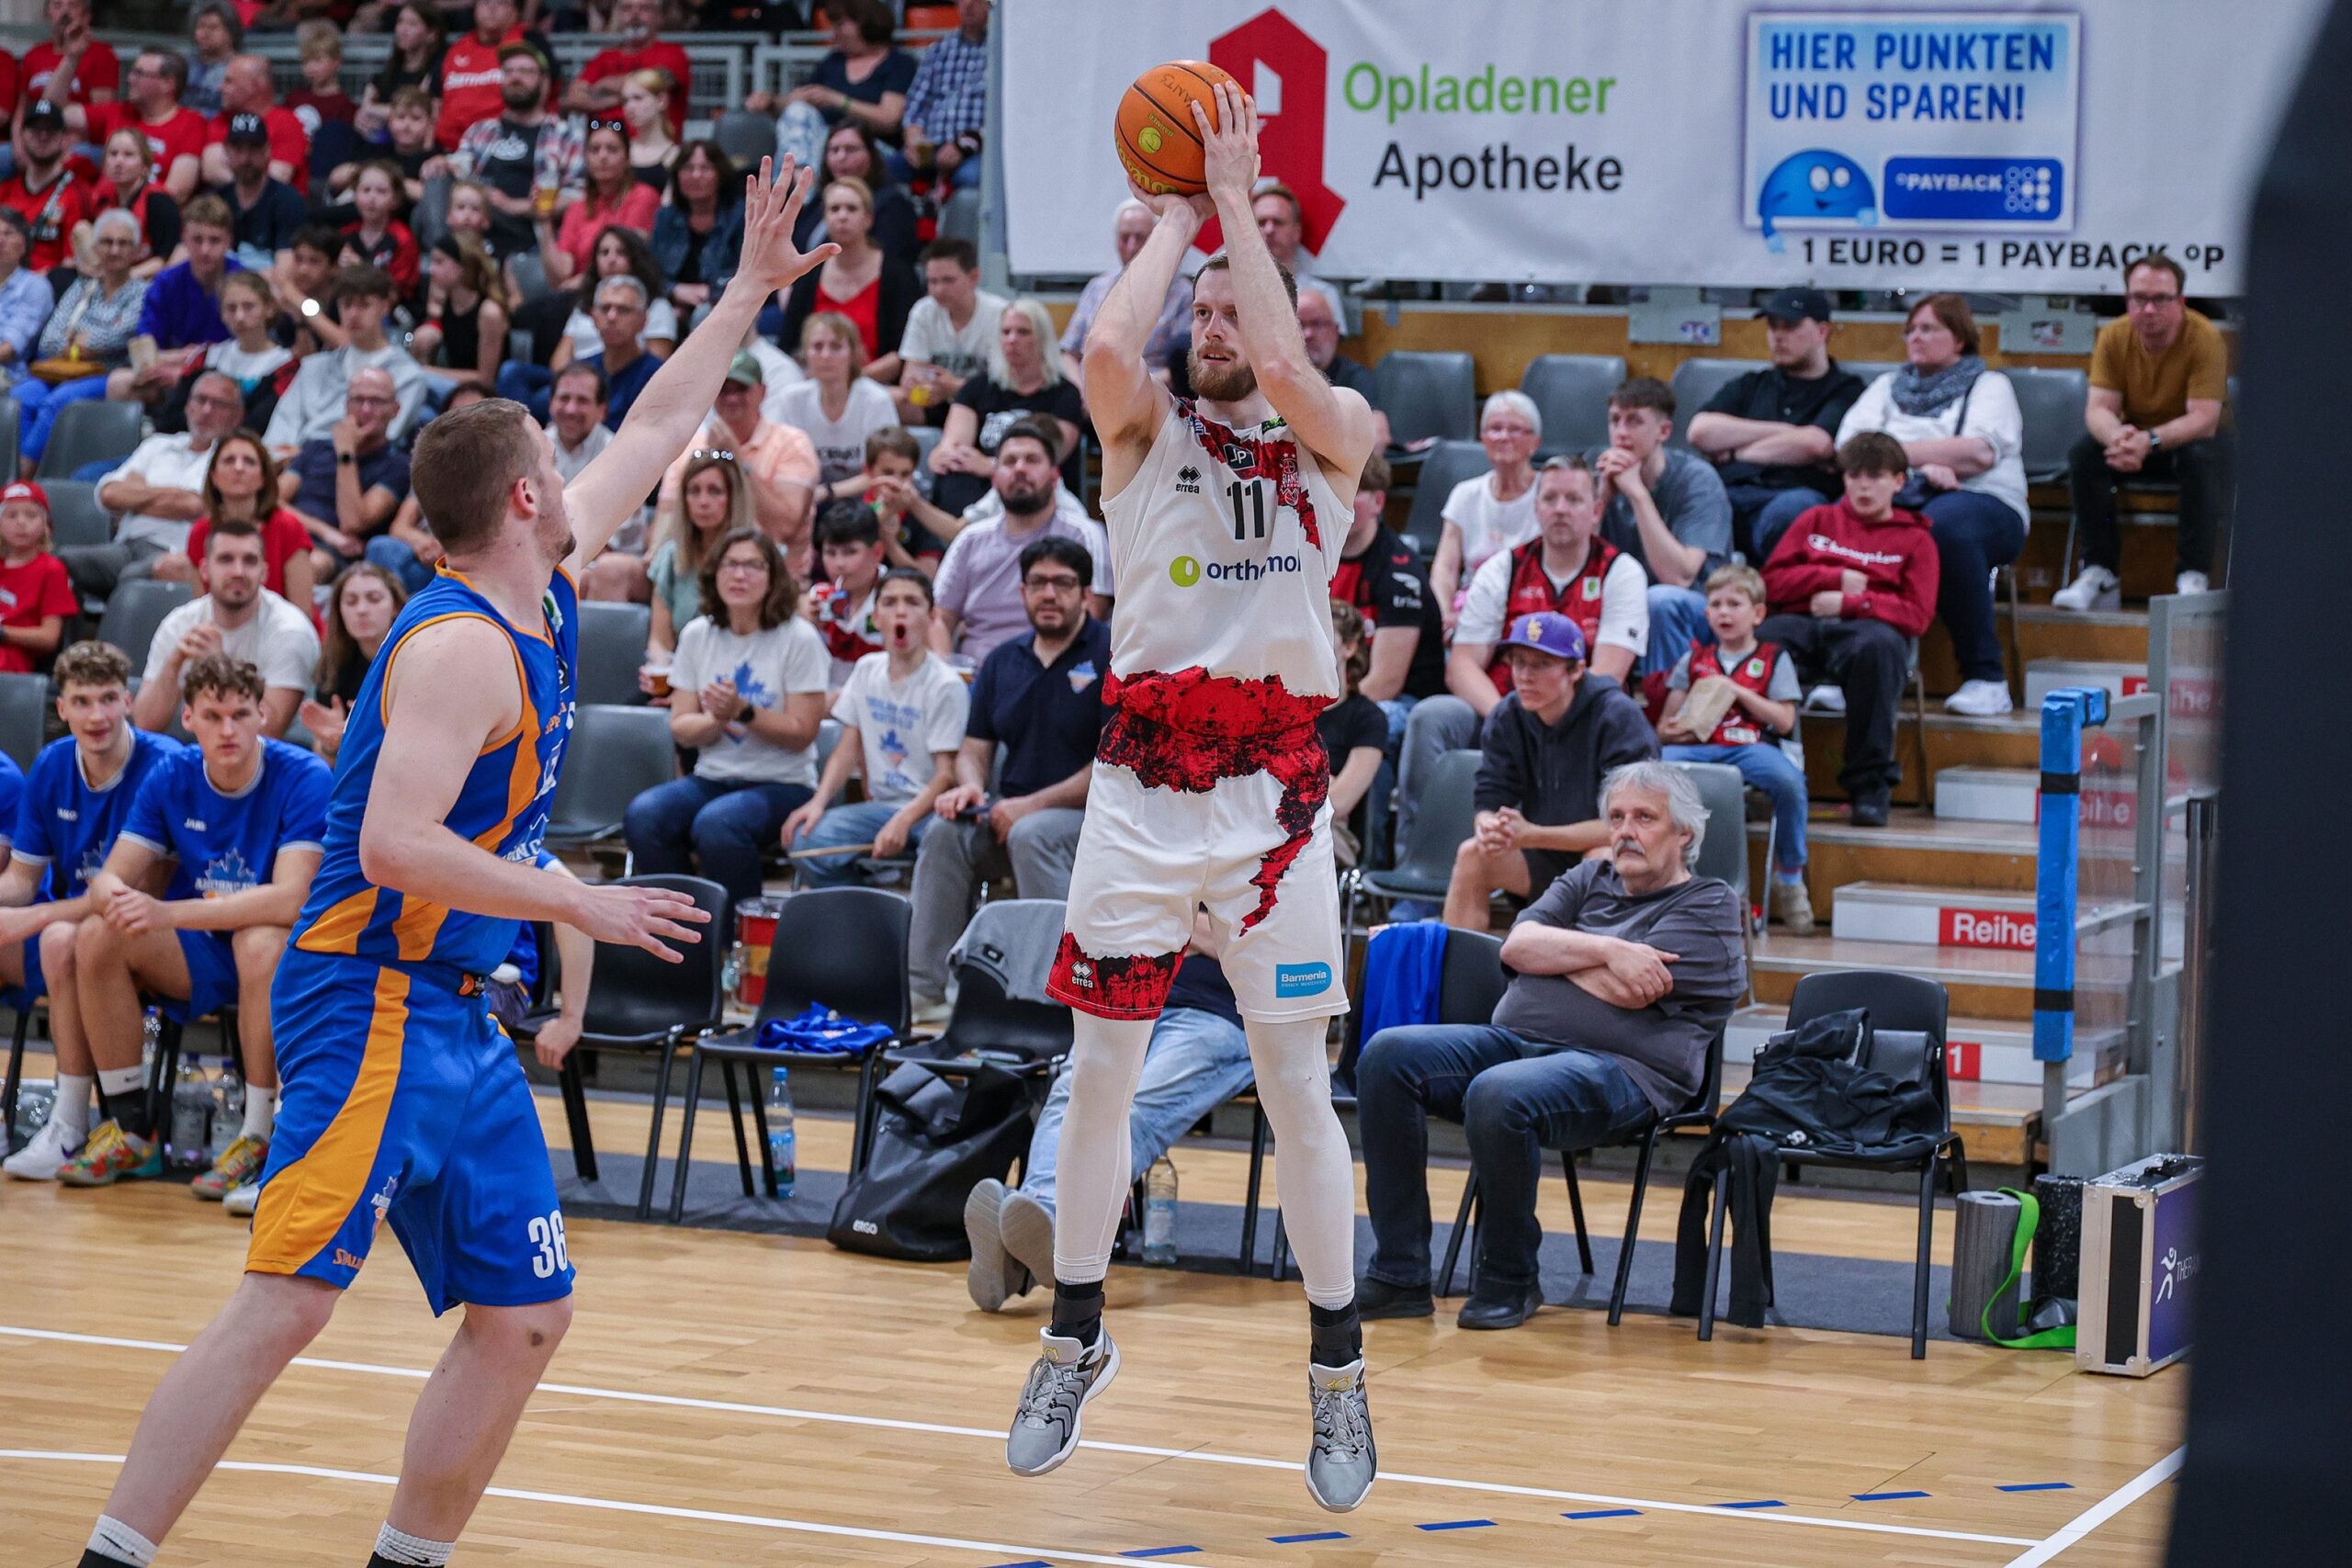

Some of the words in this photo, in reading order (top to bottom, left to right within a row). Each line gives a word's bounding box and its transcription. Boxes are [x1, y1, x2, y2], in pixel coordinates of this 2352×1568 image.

[1770, 33, 1856, 70] HIER
[1875, 33, 2053, 71] PUNKTEN
[1344, 62, 1617, 124] Opladener
[1770, 83, 1847, 119] UND
[1866, 84, 2024, 121] SPAREN!
[1373, 141, 1623, 201] Apotheke
[1803, 239, 1815, 264] 1
[1830, 239, 1926, 265] EURO
[1942, 246, 1961, 263] =
[1975, 242, 1985, 266] 1
[1175, 483, 1200, 494] errea
[1227, 479, 1265, 540] 11
[1952, 912, 2036, 946] Reihe
[1071, 976, 1093, 988] errea
[1282, 970, 1327, 983] Barmenia
[1949, 1043, 1962, 1074] 1
[527, 1209, 568, 1279] 36
